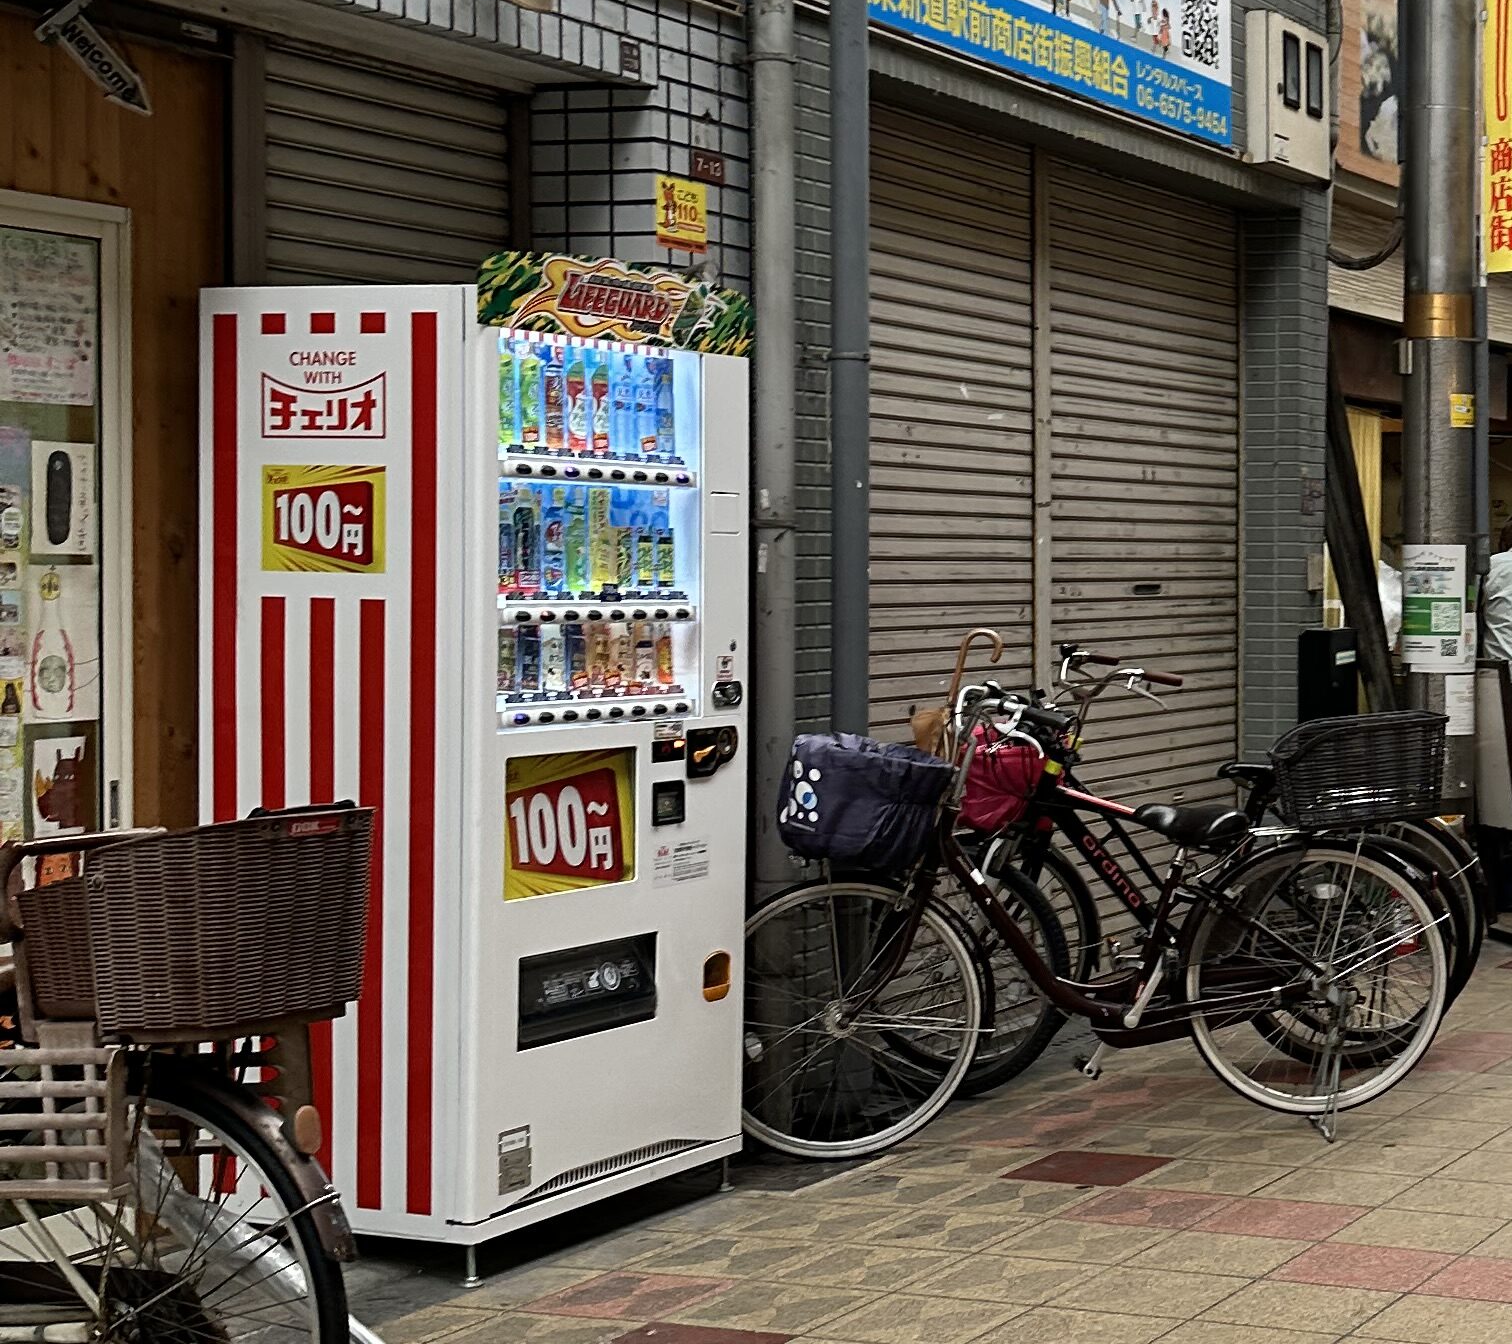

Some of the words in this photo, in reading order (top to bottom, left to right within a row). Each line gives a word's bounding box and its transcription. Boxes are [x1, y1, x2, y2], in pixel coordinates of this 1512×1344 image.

[289, 351, 357, 366] CHANGE
[304, 371, 343, 385] WITH
[270, 387, 378, 431] チェリオ
[1083, 834, 1142, 909] ordino
